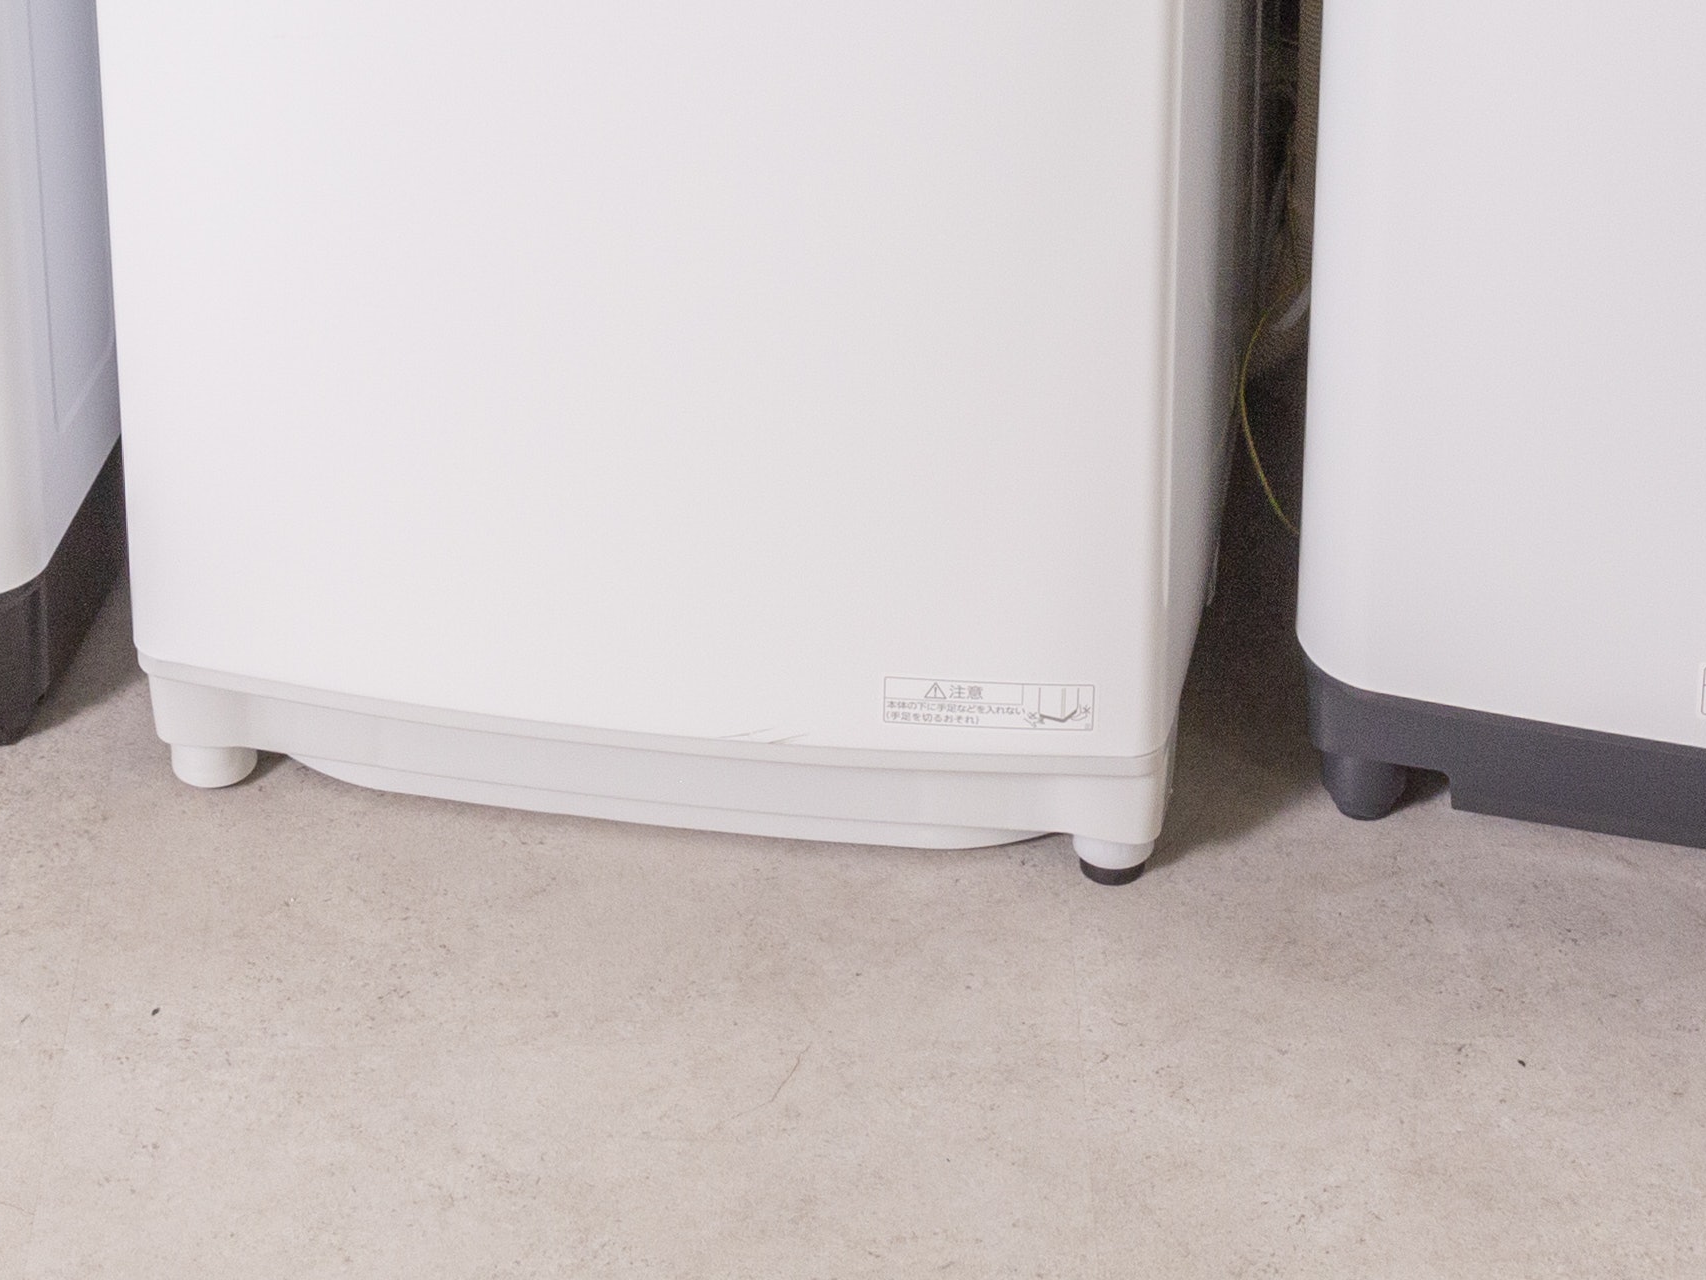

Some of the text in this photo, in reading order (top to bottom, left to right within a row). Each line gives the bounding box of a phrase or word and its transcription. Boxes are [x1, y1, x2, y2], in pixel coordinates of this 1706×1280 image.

[948, 684, 984, 700] 注意
[886, 700, 1025, 716] 本体の下に手足などを入れない
